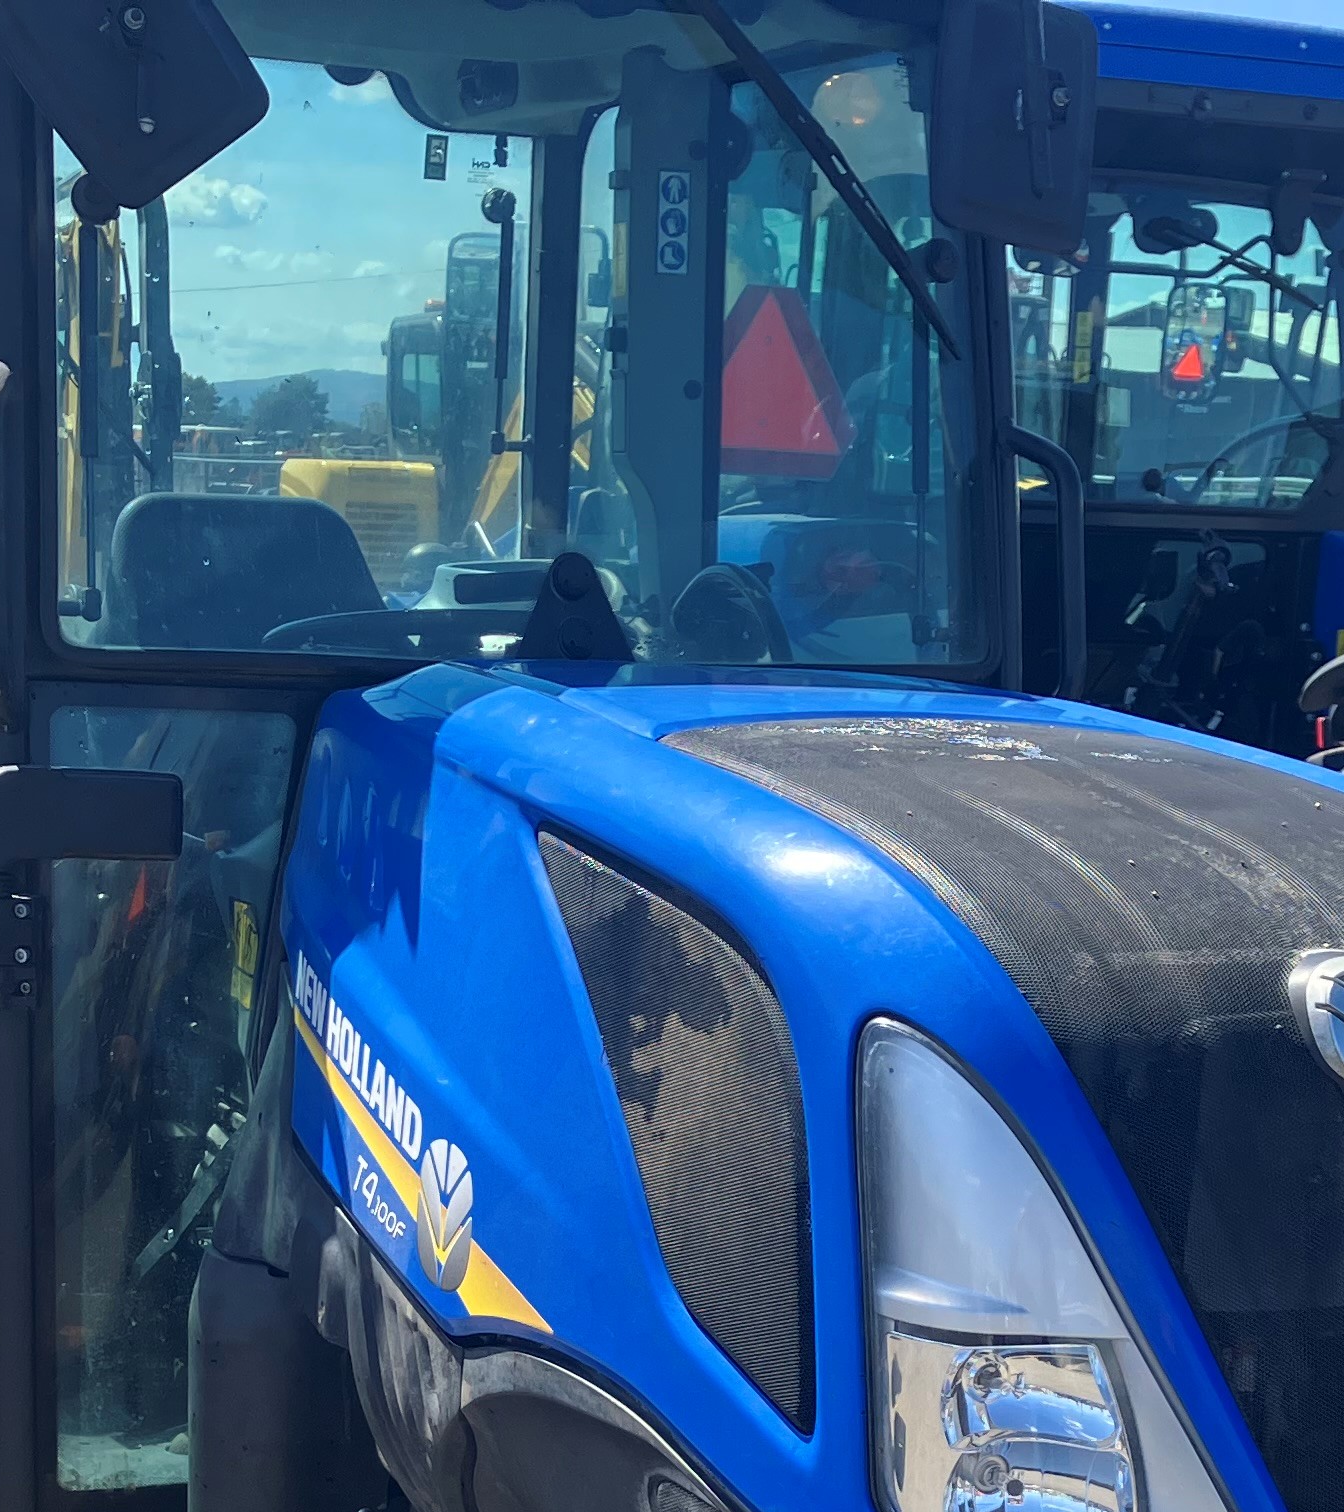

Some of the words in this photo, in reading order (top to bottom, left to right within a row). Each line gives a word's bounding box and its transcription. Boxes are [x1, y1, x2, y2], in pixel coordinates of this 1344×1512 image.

[294, 949, 328, 1037] NEW
[326, 996, 423, 1162] HOLLAND
[352, 1155, 407, 1240] T4.100F
